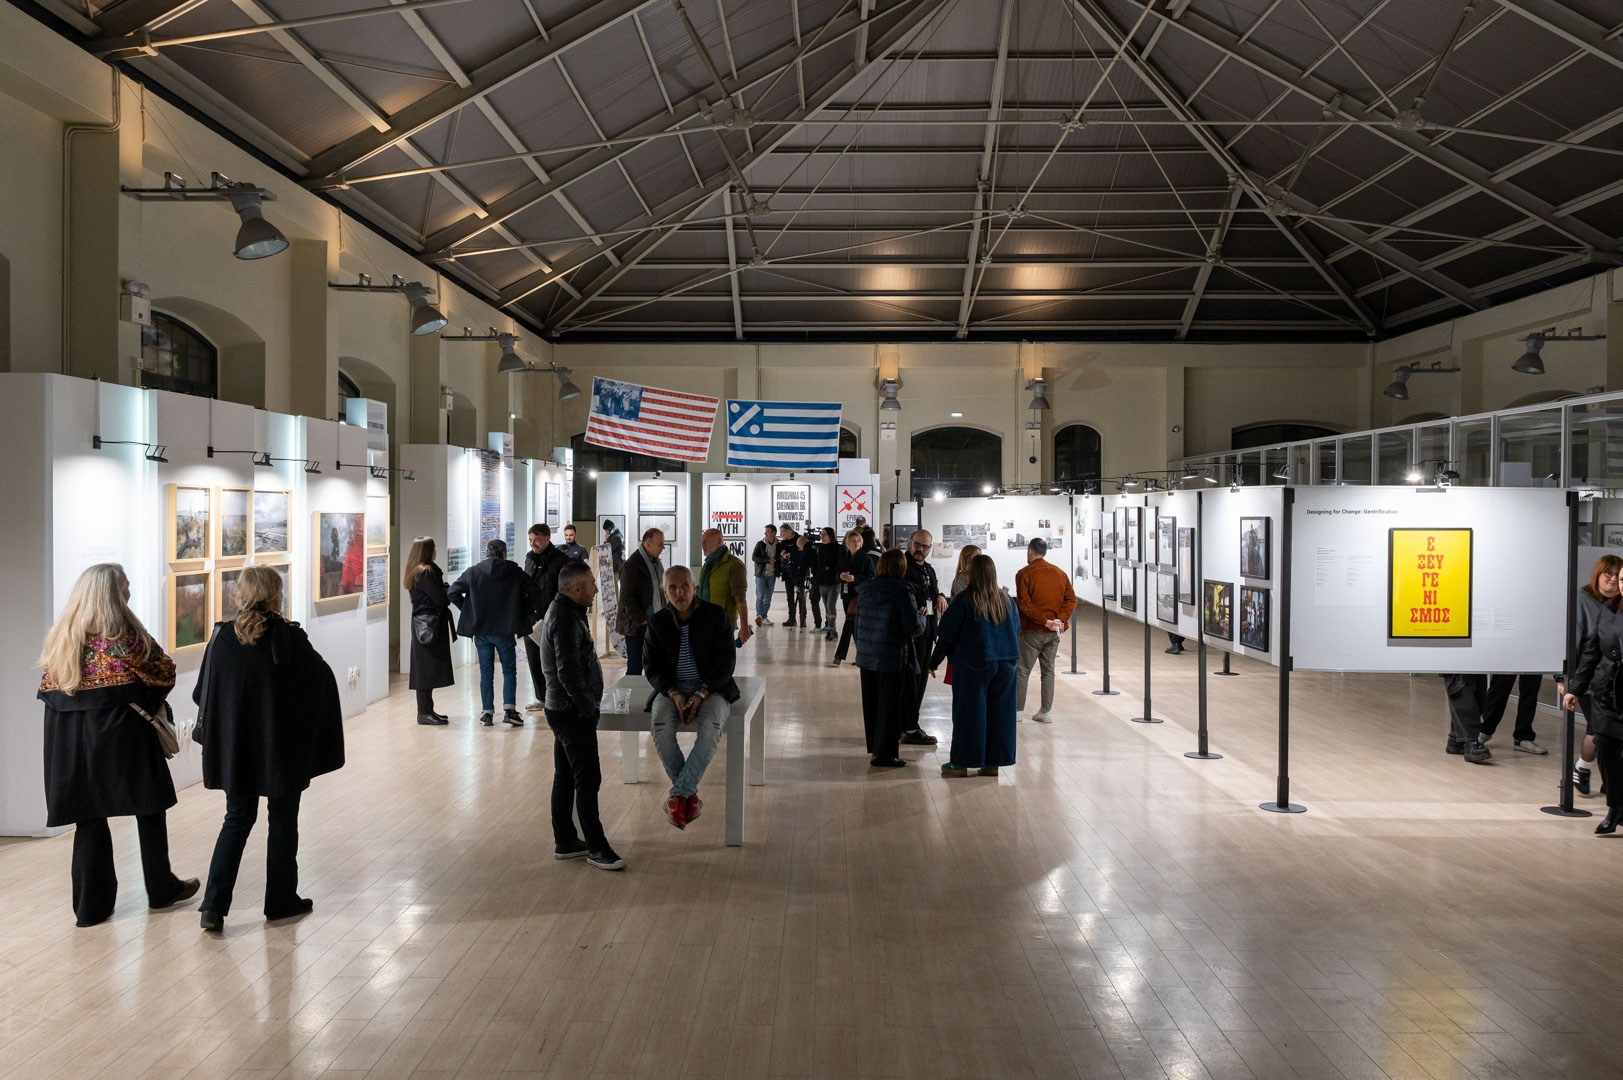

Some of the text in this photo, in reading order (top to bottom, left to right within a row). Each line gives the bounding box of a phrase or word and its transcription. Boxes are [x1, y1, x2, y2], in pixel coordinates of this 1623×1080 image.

[776, 491, 806, 500] HIROSHIMA 45
[776, 502, 799, 510] CHERNOBYL
[712, 512, 742, 522] ΧΡΥΣΗ
[778, 512, 804, 520] WINDOWS 95
[717, 523, 738, 534] ΑΥΓΗ
[1426, 536, 1435, 552] Ε
[1418, 554, 1444, 570] ΞΕΥ
[1422, 572, 1439, 588] ΓΕ
[1423, 590, 1437, 605] ΝΙ
[1410, 608, 1450, 623] ΣΜΟΣ
